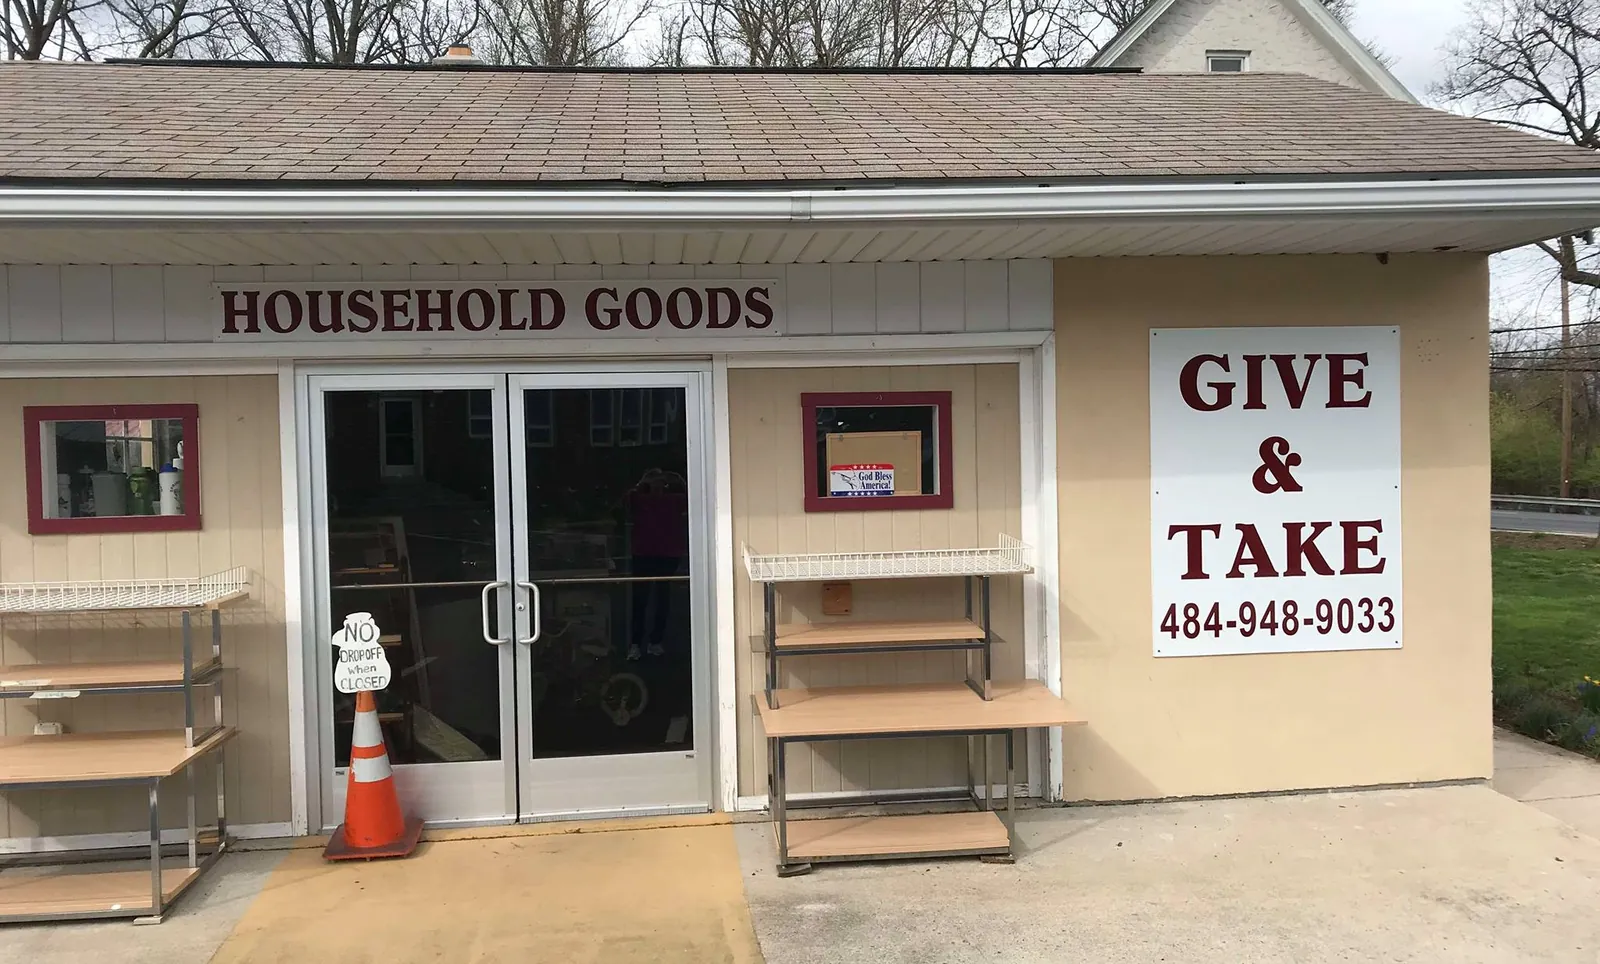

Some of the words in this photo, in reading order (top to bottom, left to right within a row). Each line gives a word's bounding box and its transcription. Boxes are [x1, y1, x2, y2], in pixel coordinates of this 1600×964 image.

[221, 288, 566, 334] HOUSEHOLD
[584, 286, 774, 331] GOODS
[1179, 352, 1373, 412] GIVE
[858, 471, 873, 481] God
[874, 471, 893, 481] Bless
[1252, 436, 1304, 494] &
[860, 480, 891, 490] America!
[1167, 519, 1387, 580] TAKE
[344, 622, 374, 642] NO
[1160, 596, 1395, 639] 484-948-9033
[340, 676, 387, 690] CLOSED
[347, 664, 377, 675] when
